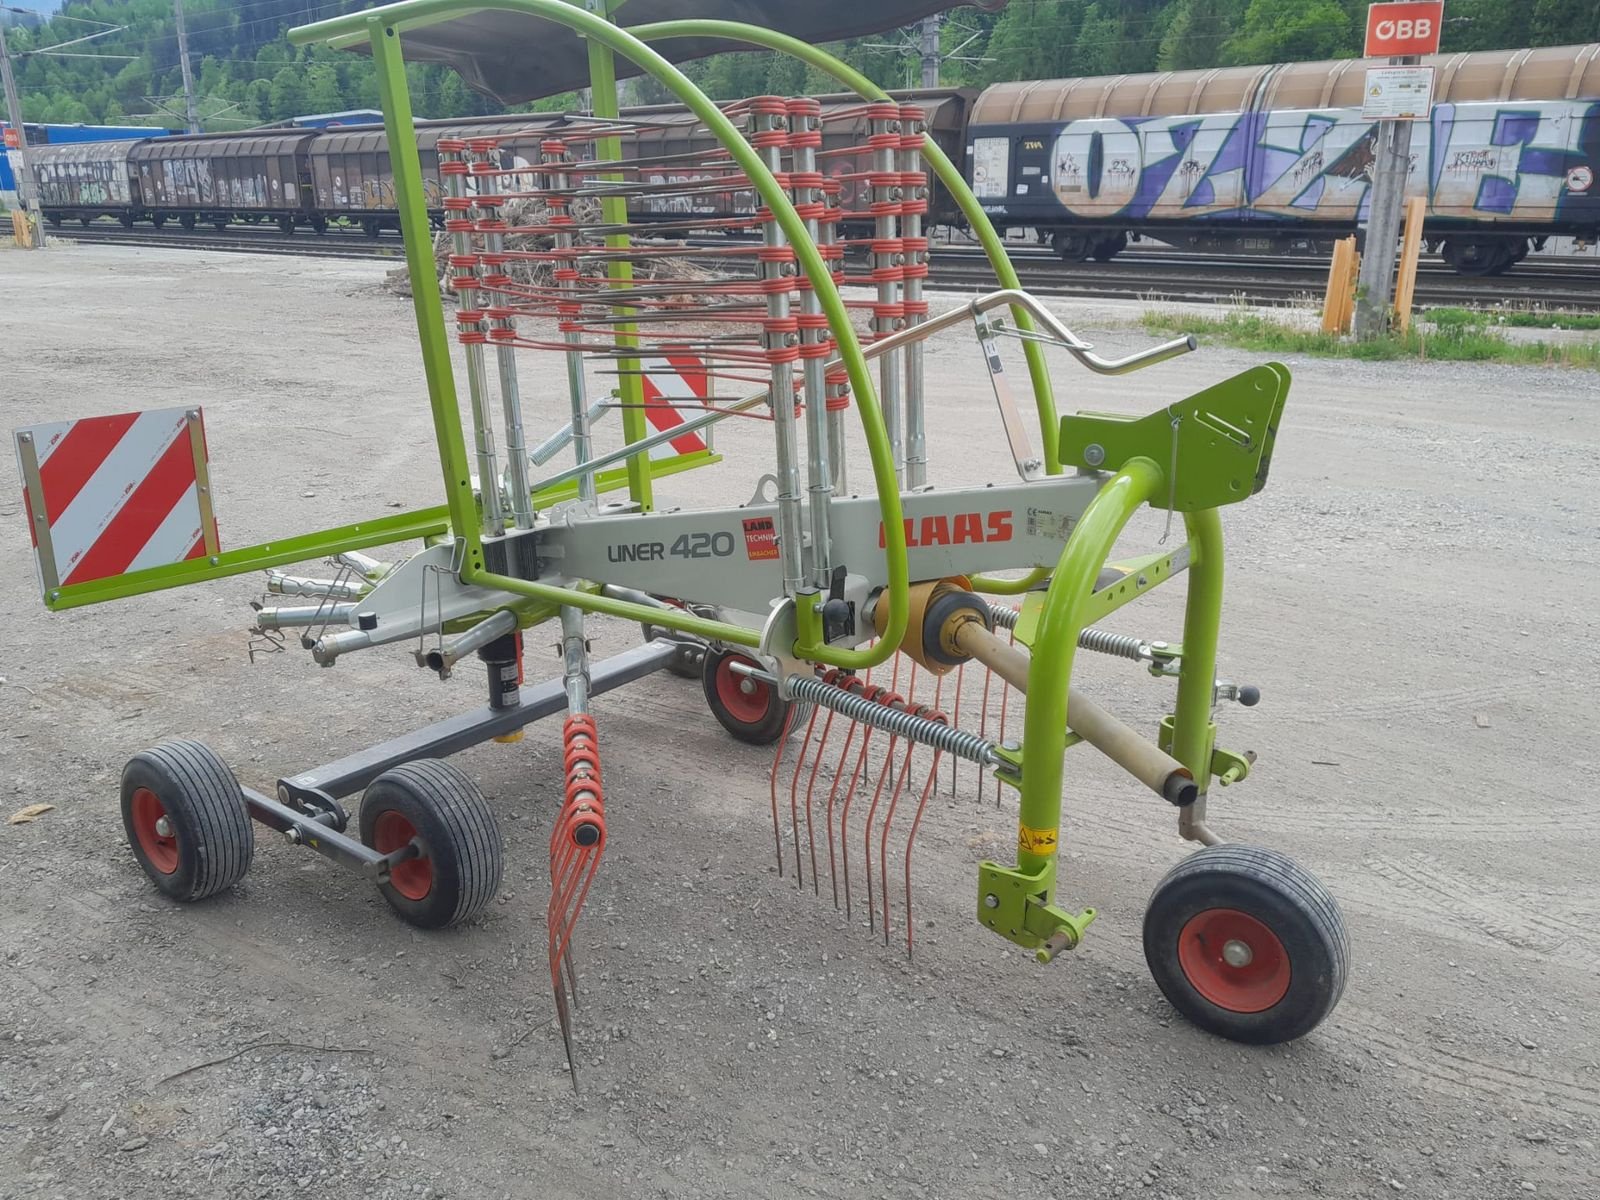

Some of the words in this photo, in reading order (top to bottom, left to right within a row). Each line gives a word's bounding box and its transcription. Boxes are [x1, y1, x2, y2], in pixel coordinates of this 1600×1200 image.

[1375, 18, 1432, 41] ÖBB
[744, 520, 773, 531] LAND
[879, 511, 1013, 548] LAAS
[608, 542, 665, 563] LINER
[670, 532, 735, 559] 420
